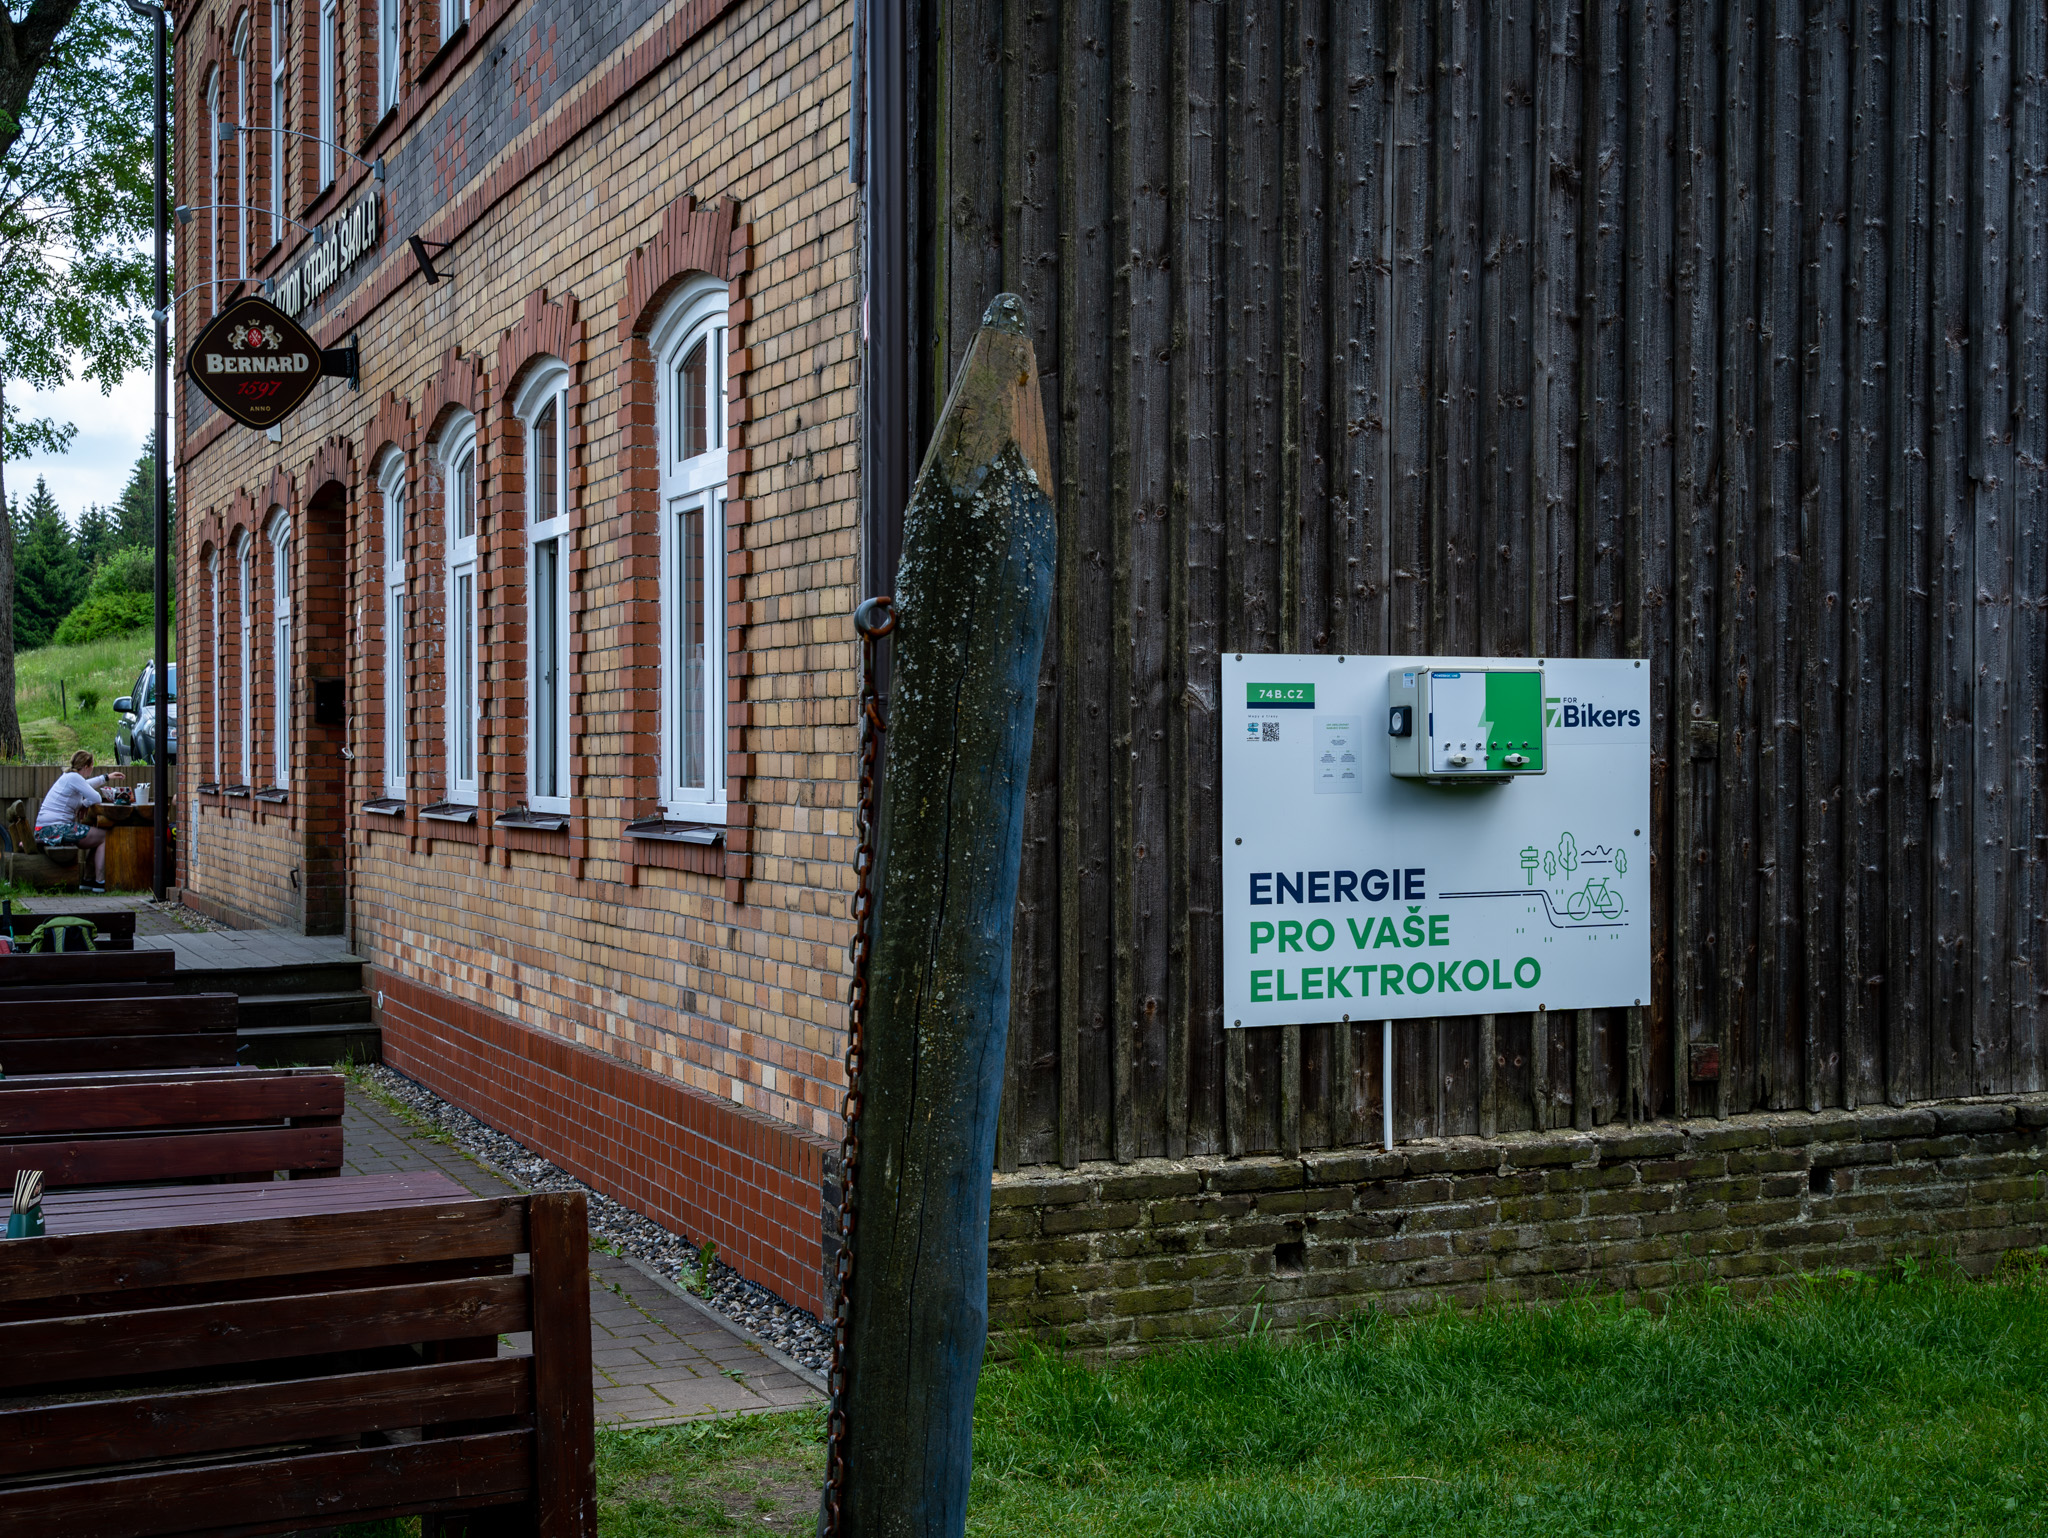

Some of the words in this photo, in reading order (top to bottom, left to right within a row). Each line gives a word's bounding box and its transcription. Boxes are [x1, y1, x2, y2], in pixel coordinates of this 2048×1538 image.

[304, 221, 338, 307] STARÁ
[340, 191, 376, 273] ŠKOLA
[206, 353, 309, 374] BERNARD
[237, 381, 282, 400] 1597
[1259, 689, 1304, 699] 74B.CZ
[1563, 703, 1641, 727] Bikers
[1249, 867, 1426, 906] ENERGIE
[1250, 918, 1335, 954] PRO
[1346, 906, 1450, 950] VAŠE
[1250, 956, 1541, 1002] ELEKTROKOLO
